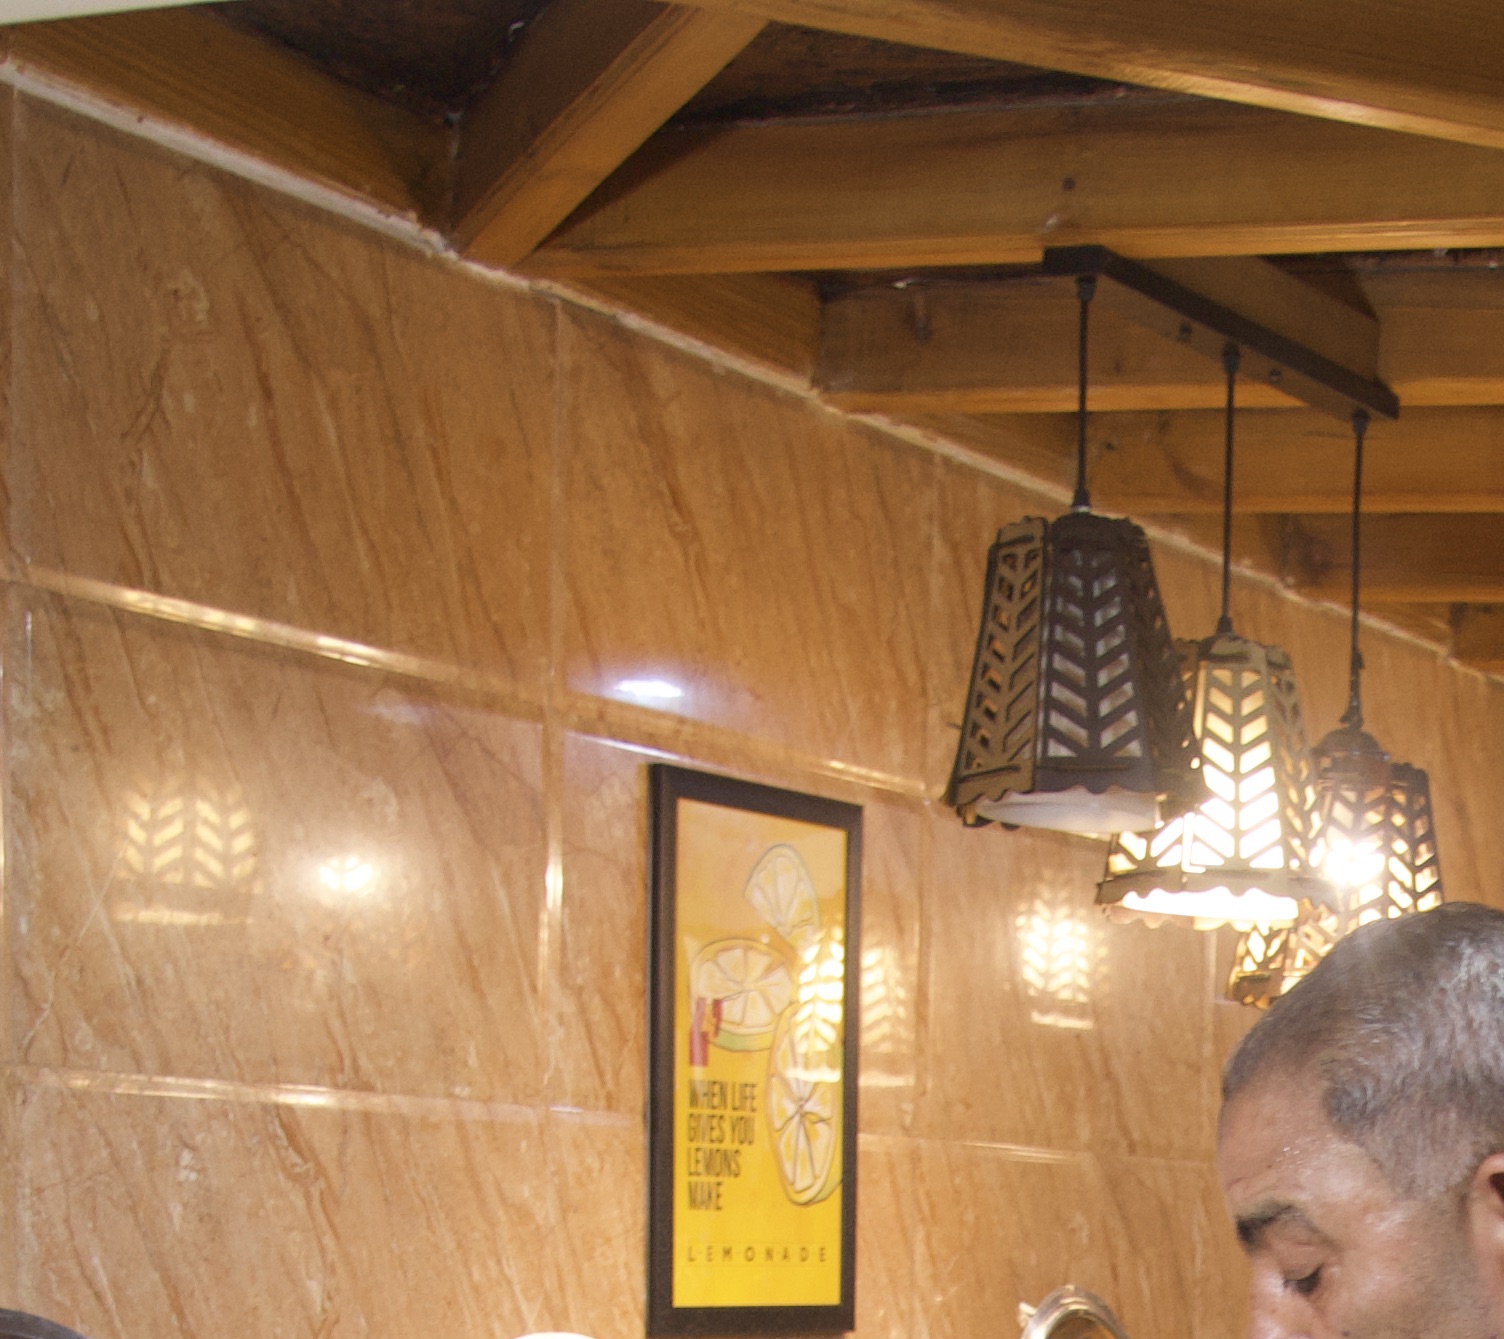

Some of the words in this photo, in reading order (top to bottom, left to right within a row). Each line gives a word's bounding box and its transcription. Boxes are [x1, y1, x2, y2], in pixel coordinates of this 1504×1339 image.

[688, 1080, 728, 1110] WHEN
[732, 1082, 757, 1112] LIFE
[688, 1113, 725, 1144] GIVES
[729, 1115, 756, 1146] YOU
[688, 1147, 741, 1178] LEMONS
[688, 1181, 723, 1211] MAKE
[688, 1246, 827, 1263] LEMONADE
